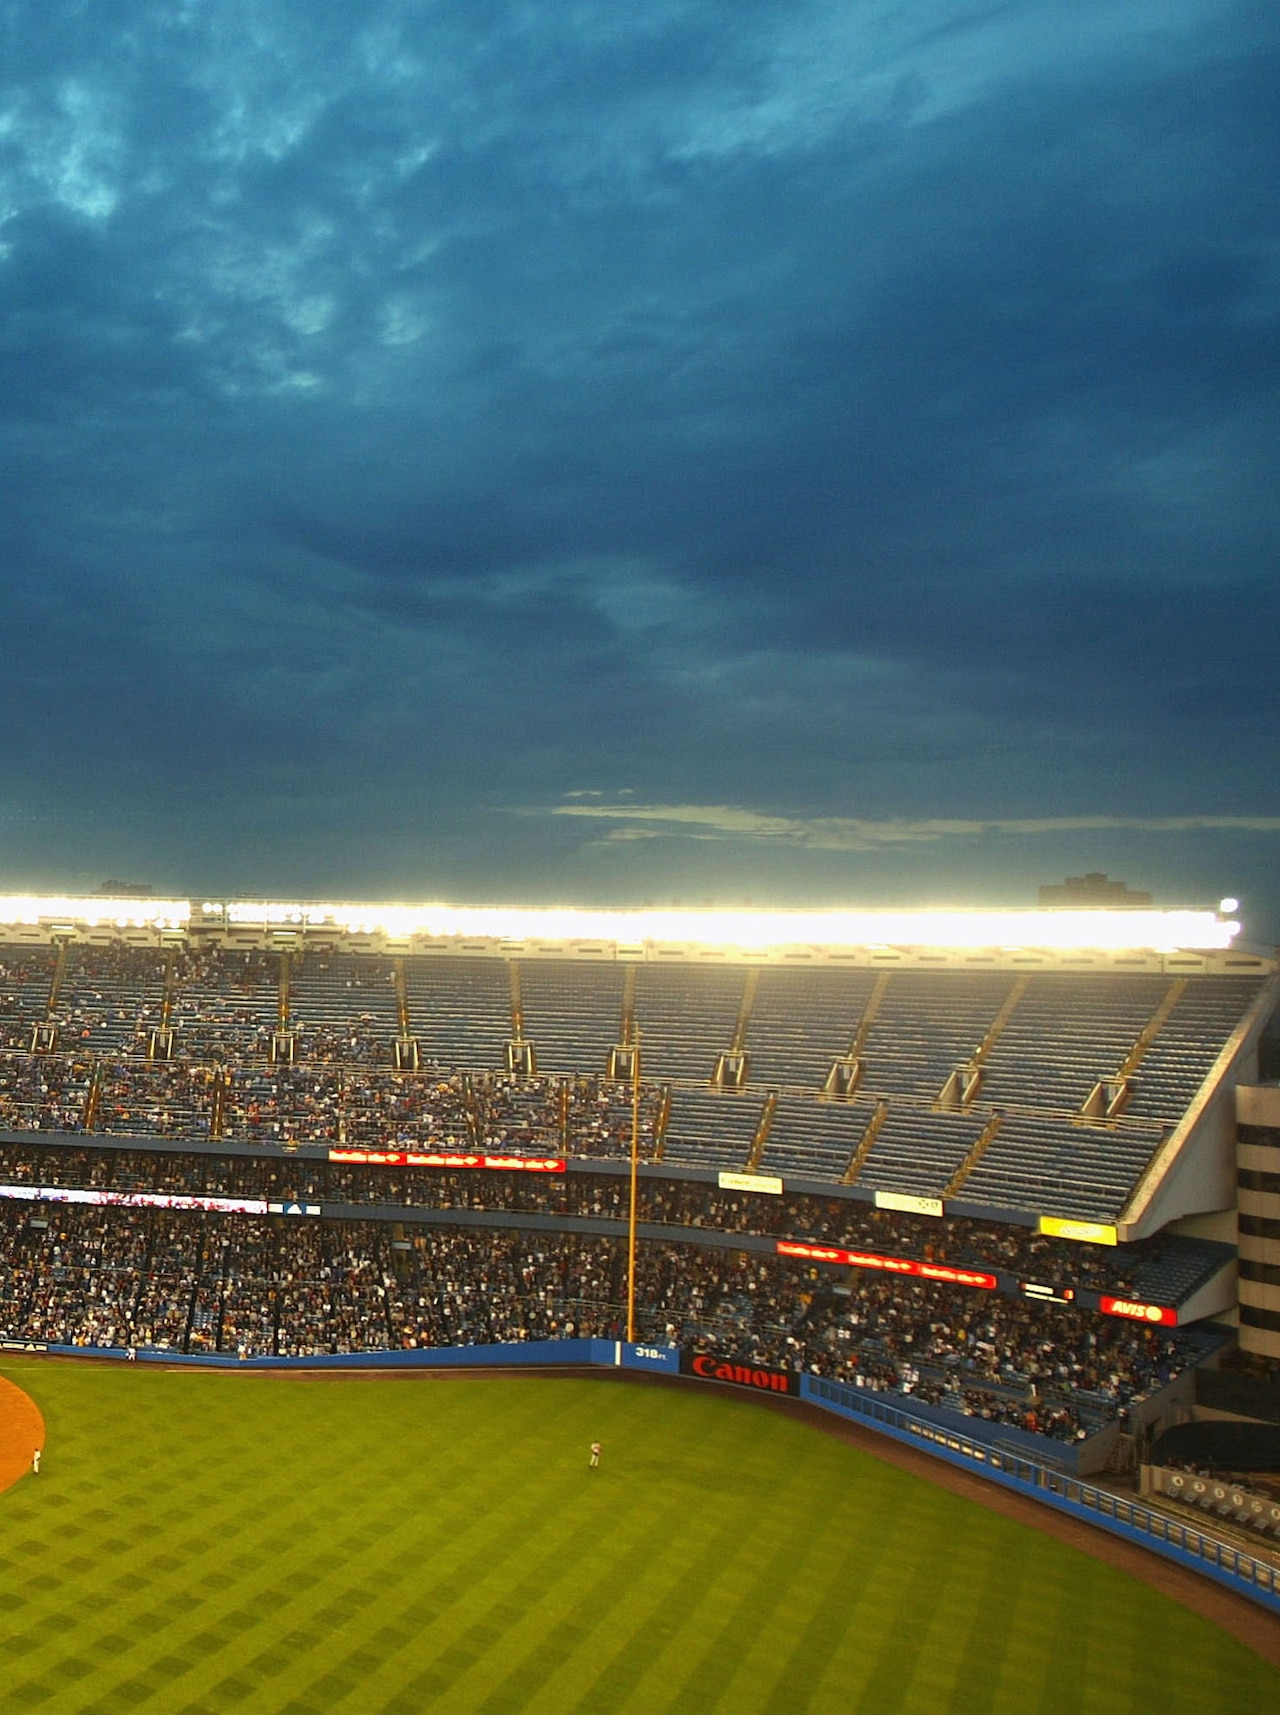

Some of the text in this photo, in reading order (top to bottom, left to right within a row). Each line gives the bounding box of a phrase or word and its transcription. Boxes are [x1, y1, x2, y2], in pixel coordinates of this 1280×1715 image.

[1111, 1301, 1146, 1317] AVIS
[635, 1347, 658, 1359] 318
[692, 1356, 789, 1393] Canon
